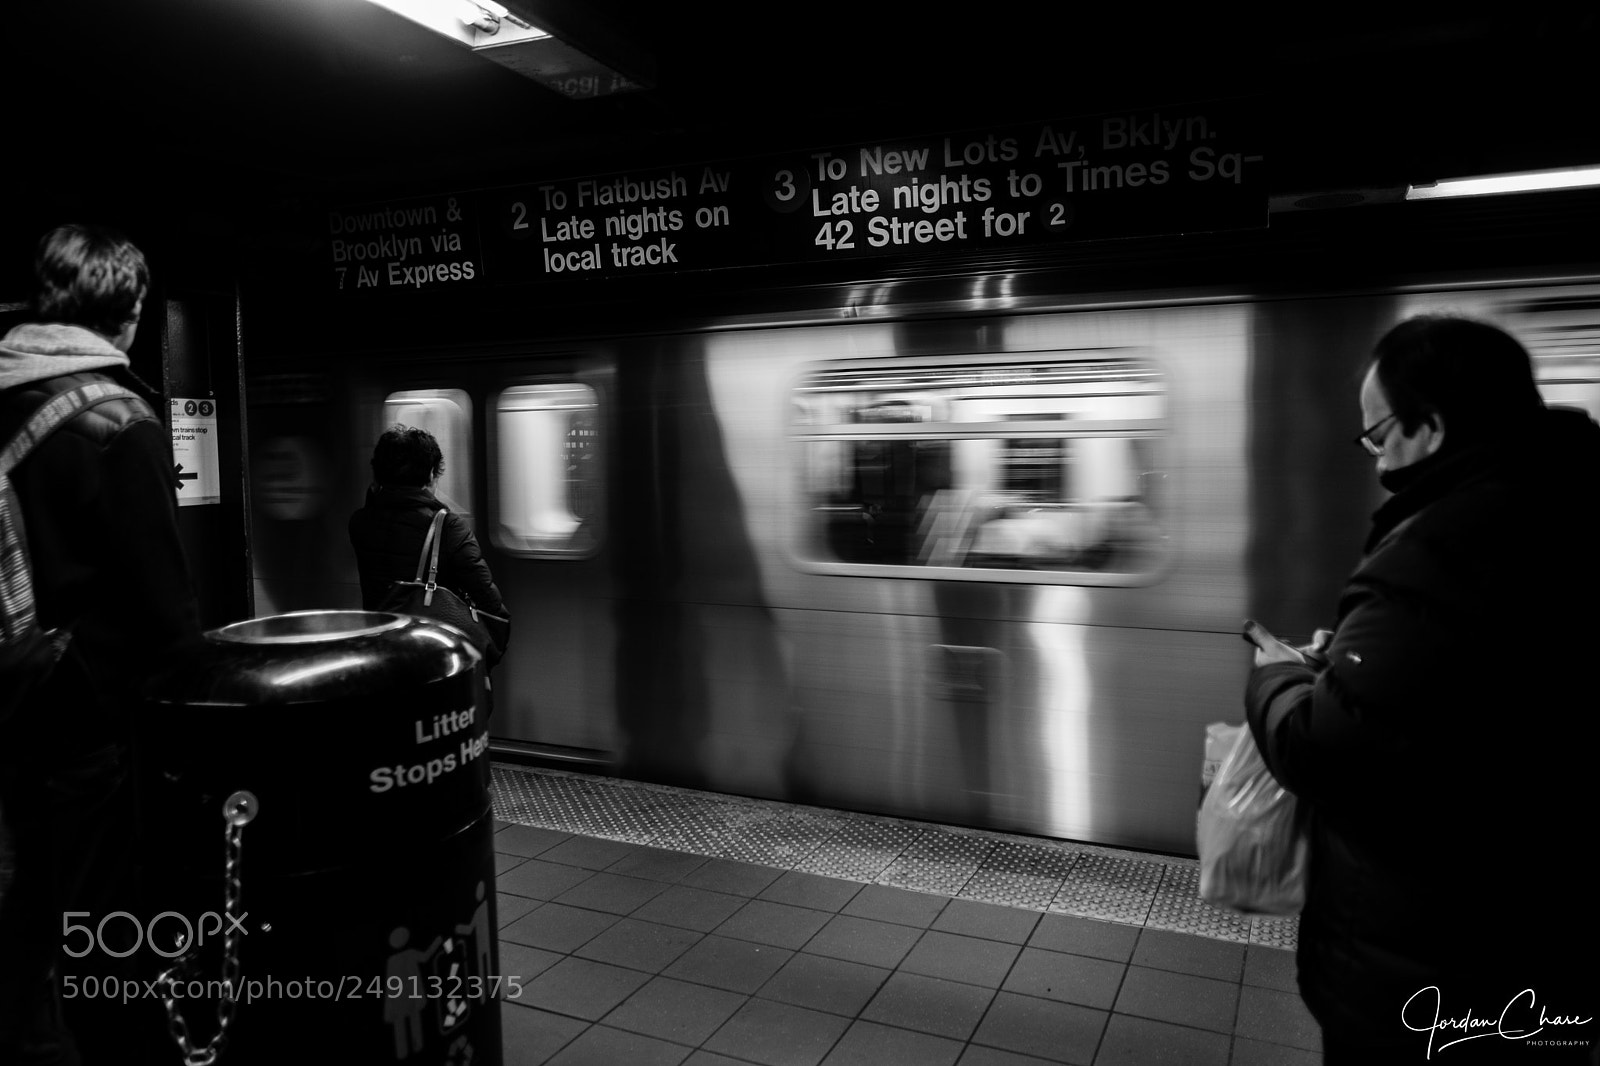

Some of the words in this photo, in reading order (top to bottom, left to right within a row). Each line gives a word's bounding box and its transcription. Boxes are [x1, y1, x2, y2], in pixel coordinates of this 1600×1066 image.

[811, 151, 847, 182] To
[859, 144, 930, 177] New
[943, 136, 1019, 168] Lots
[1034, 125, 1085, 160] Av,
[1102, 113, 1217, 150] Bklyn.
[538, 184, 568, 212] To
[577, 170, 688, 208] Flatbush
[699, 167, 732, 195] Av
[773, 169, 796, 202] 3
[811, 184, 880, 218] Late
[893, 174, 993, 214] nights
[1007, 169, 1043, 198] to
[1057, 159, 1171, 194] Times
[328, 205, 438, 236] Downtown
[446, 197, 463, 223] &
[510, 201, 530, 231] 2
[541, 215, 595, 243] Late
[605, 205, 684, 240] nights
[695, 205, 731, 229] on
[814, 220, 856, 251] 42
[866, 211, 968, 249] Street
[982, 207, 1031, 238] for
[1048, 202, 1067, 227] 2
[331, 233, 423, 263] Brooklyn
[431, 228, 462, 254] via
[543, 243, 602, 273] local
[611, 238, 679, 268] track
[334, 266, 347, 290] 7
[357, 266, 380, 288] Av
[387, 258, 475, 288] Express
[415, 705, 476, 744] Litter
[369, 753, 457, 793] Stops
